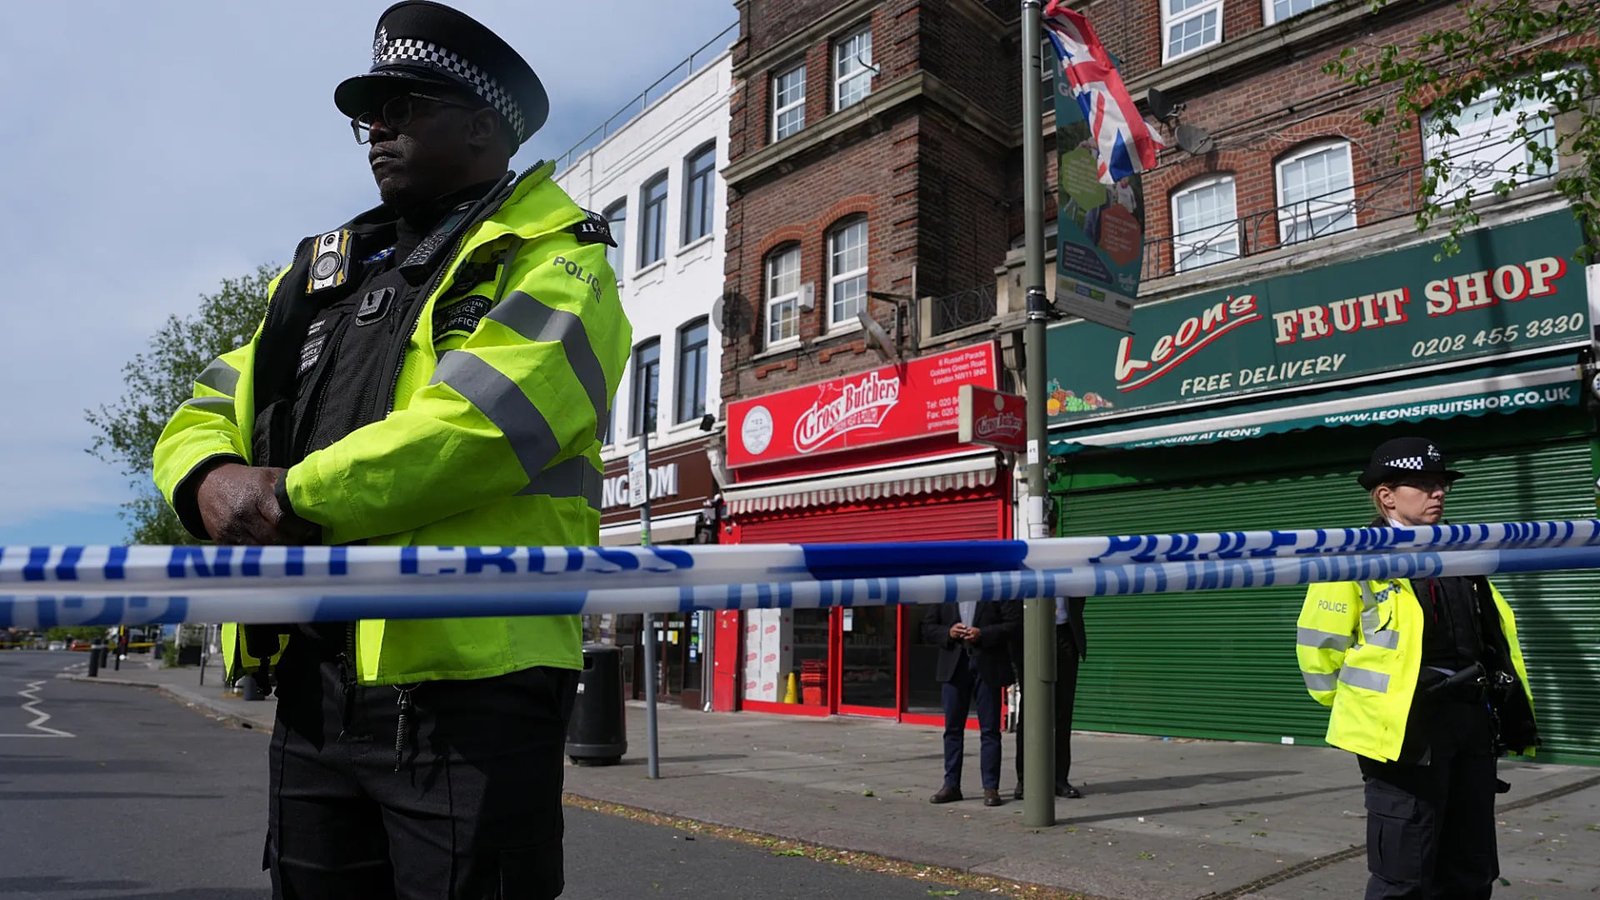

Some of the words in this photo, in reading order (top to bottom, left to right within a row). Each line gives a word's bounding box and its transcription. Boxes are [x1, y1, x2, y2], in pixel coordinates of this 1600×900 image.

[553, 256, 602, 304] POLICE
[1272, 287, 1410, 346] FRUIT
[1424, 256, 1567, 318] SHOP
[1115, 295, 1257, 383] Leon's
[1411, 334, 1466, 358] 0208
[1472, 324, 1519, 348] 455
[1526, 312, 1584, 339] 3330
[1180, 372, 1232, 396] FREE
[1239, 353, 1347, 386] DELIVERY
[801, 401, 841, 440] Gross
[845, 374, 898, 413] Butchers
[1199, 431, 1217, 441] AT
[1217, 427, 1261, 438] LEON'S
[601, 463, 678, 508] NGOM
[1318, 599, 1348, 614] POLICE
